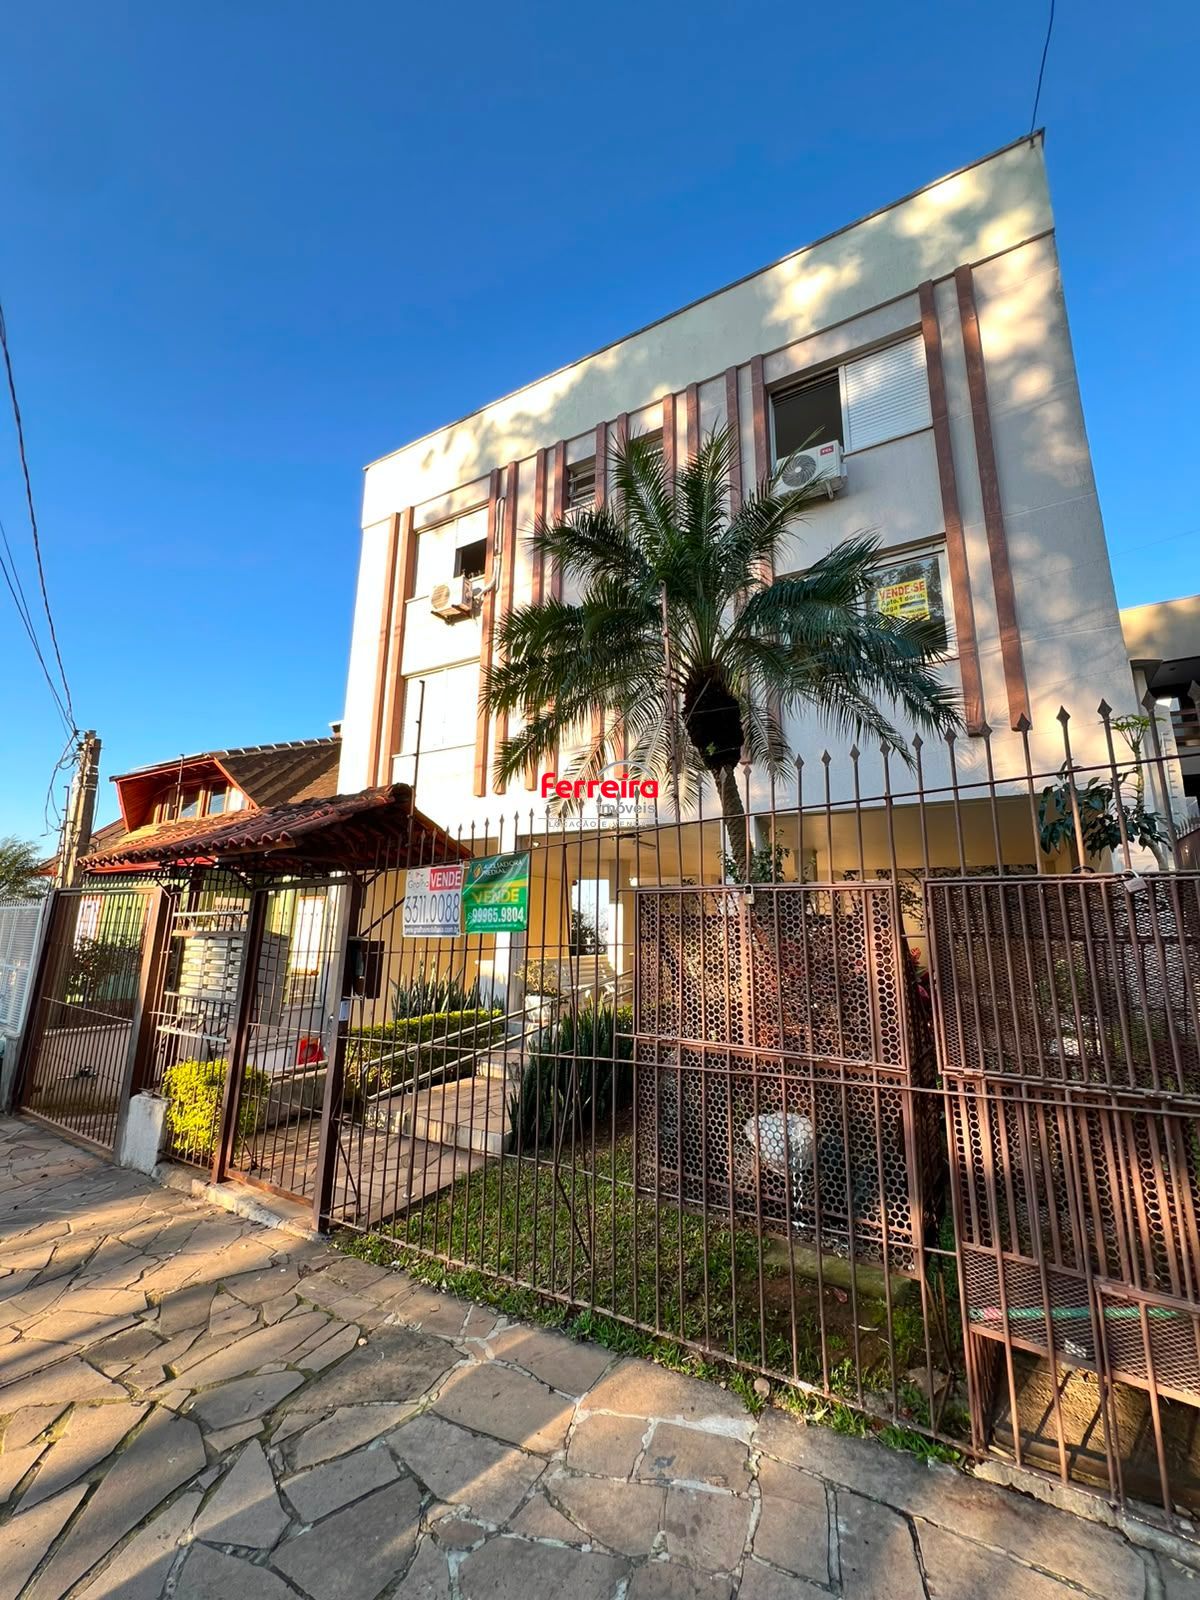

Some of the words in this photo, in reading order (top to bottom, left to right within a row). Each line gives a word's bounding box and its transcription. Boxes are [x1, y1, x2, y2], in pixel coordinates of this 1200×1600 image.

[879, 581, 925, 600] VENDE-SE
[431, 870, 462, 888] VENDE
[472, 887, 520, 904] VENDE
[404, 892, 460, 924] 3311.0088
[472, 906, 524, 923] 99965.9804
